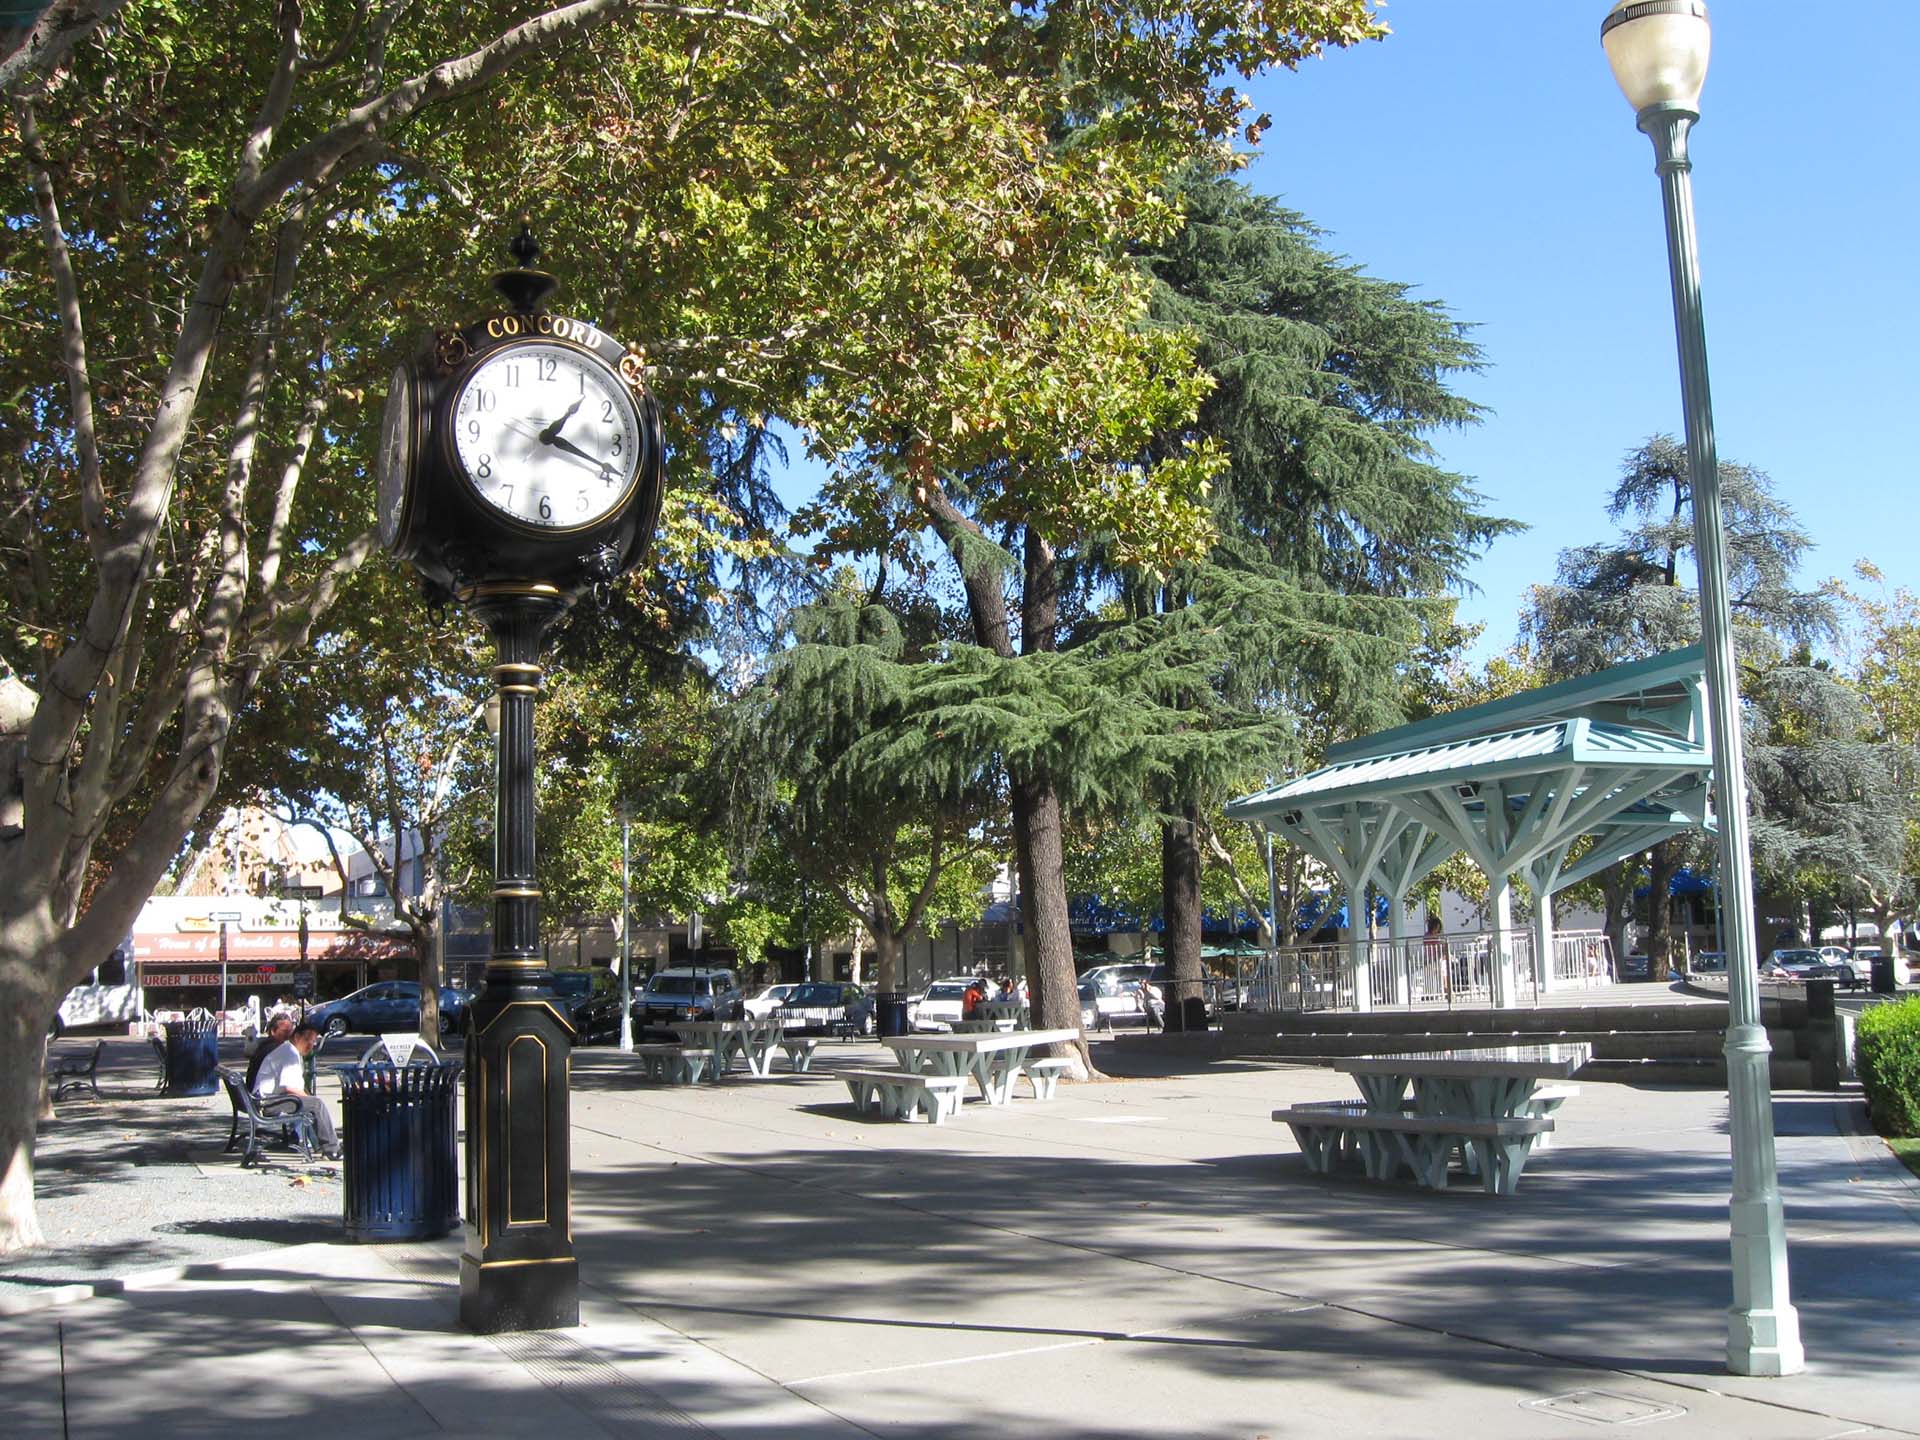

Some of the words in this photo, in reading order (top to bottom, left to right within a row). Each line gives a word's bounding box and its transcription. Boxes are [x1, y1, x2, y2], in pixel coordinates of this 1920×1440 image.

[487, 315, 602, 349] CONCORD
[506, 365, 519, 388] 11
[537, 358, 557, 382] 12
[578, 372, 585, 396] 1
[476, 388, 496, 413] 10
[601, 400, 613, 424] 2
[468, 420, 480, 444] 9
[611, 433, 622, 457] 3
[477, 453, 491, 479] 8
[500, 483, 514, 509] 7
[539, 495, 551, 520] 6
[576, 489, 589, 513] 5
[144, 975, 181, 986] URGER
[188, 974, 220, 985] FRIES
[236, 973, 272, 985] DRINK
